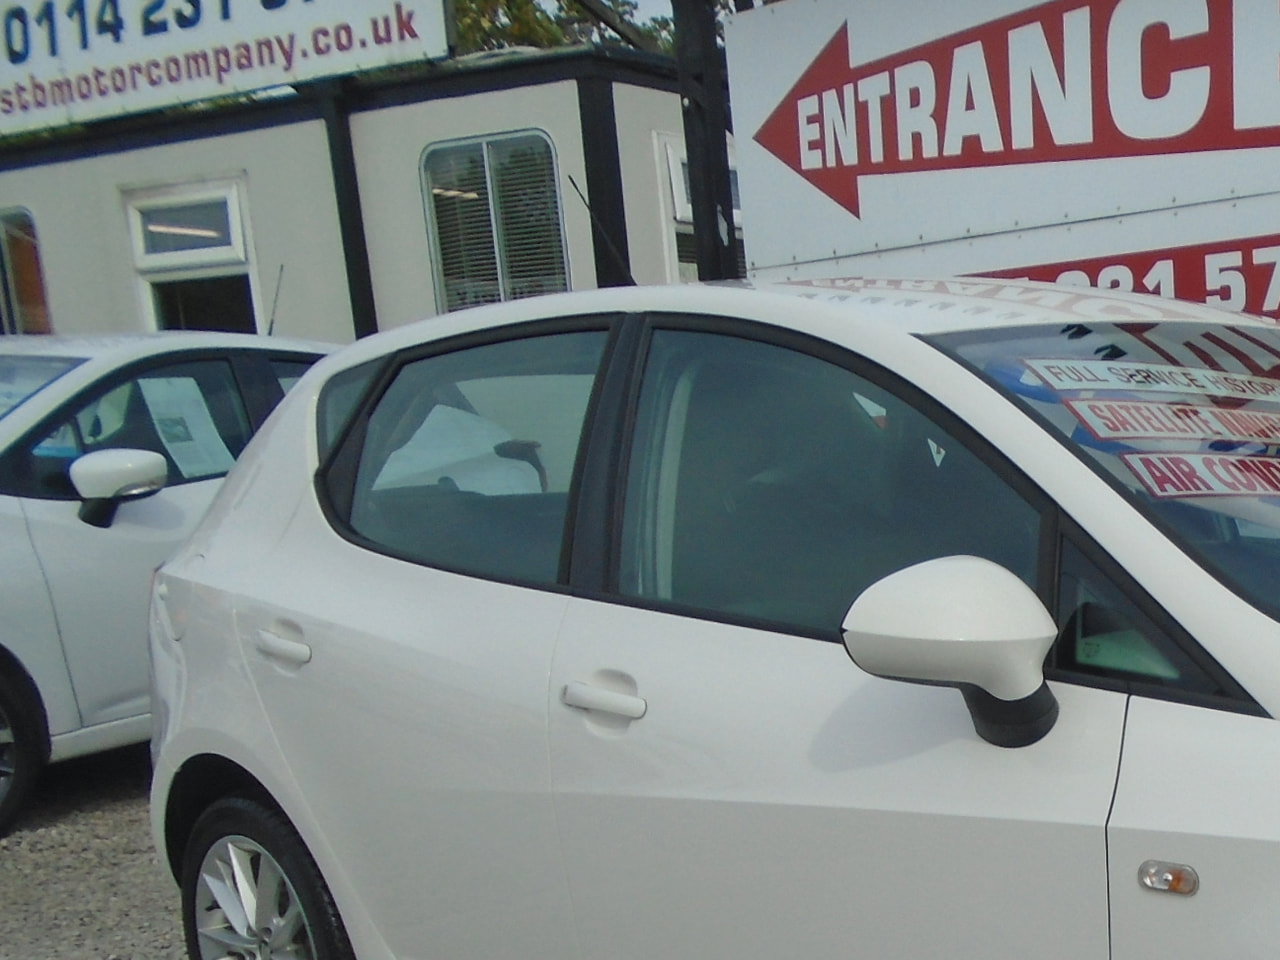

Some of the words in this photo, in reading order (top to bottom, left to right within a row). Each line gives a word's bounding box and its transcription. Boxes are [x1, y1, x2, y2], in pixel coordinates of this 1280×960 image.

[5, 0, 124, 64] 0114
[1043, 364, 1109, 383] FULL
[1107, 366, 1205, 389] SERVICE
[1087, 403, 1223, 436] SATELLITE
[1138, 455, 1214, 493] AIR
